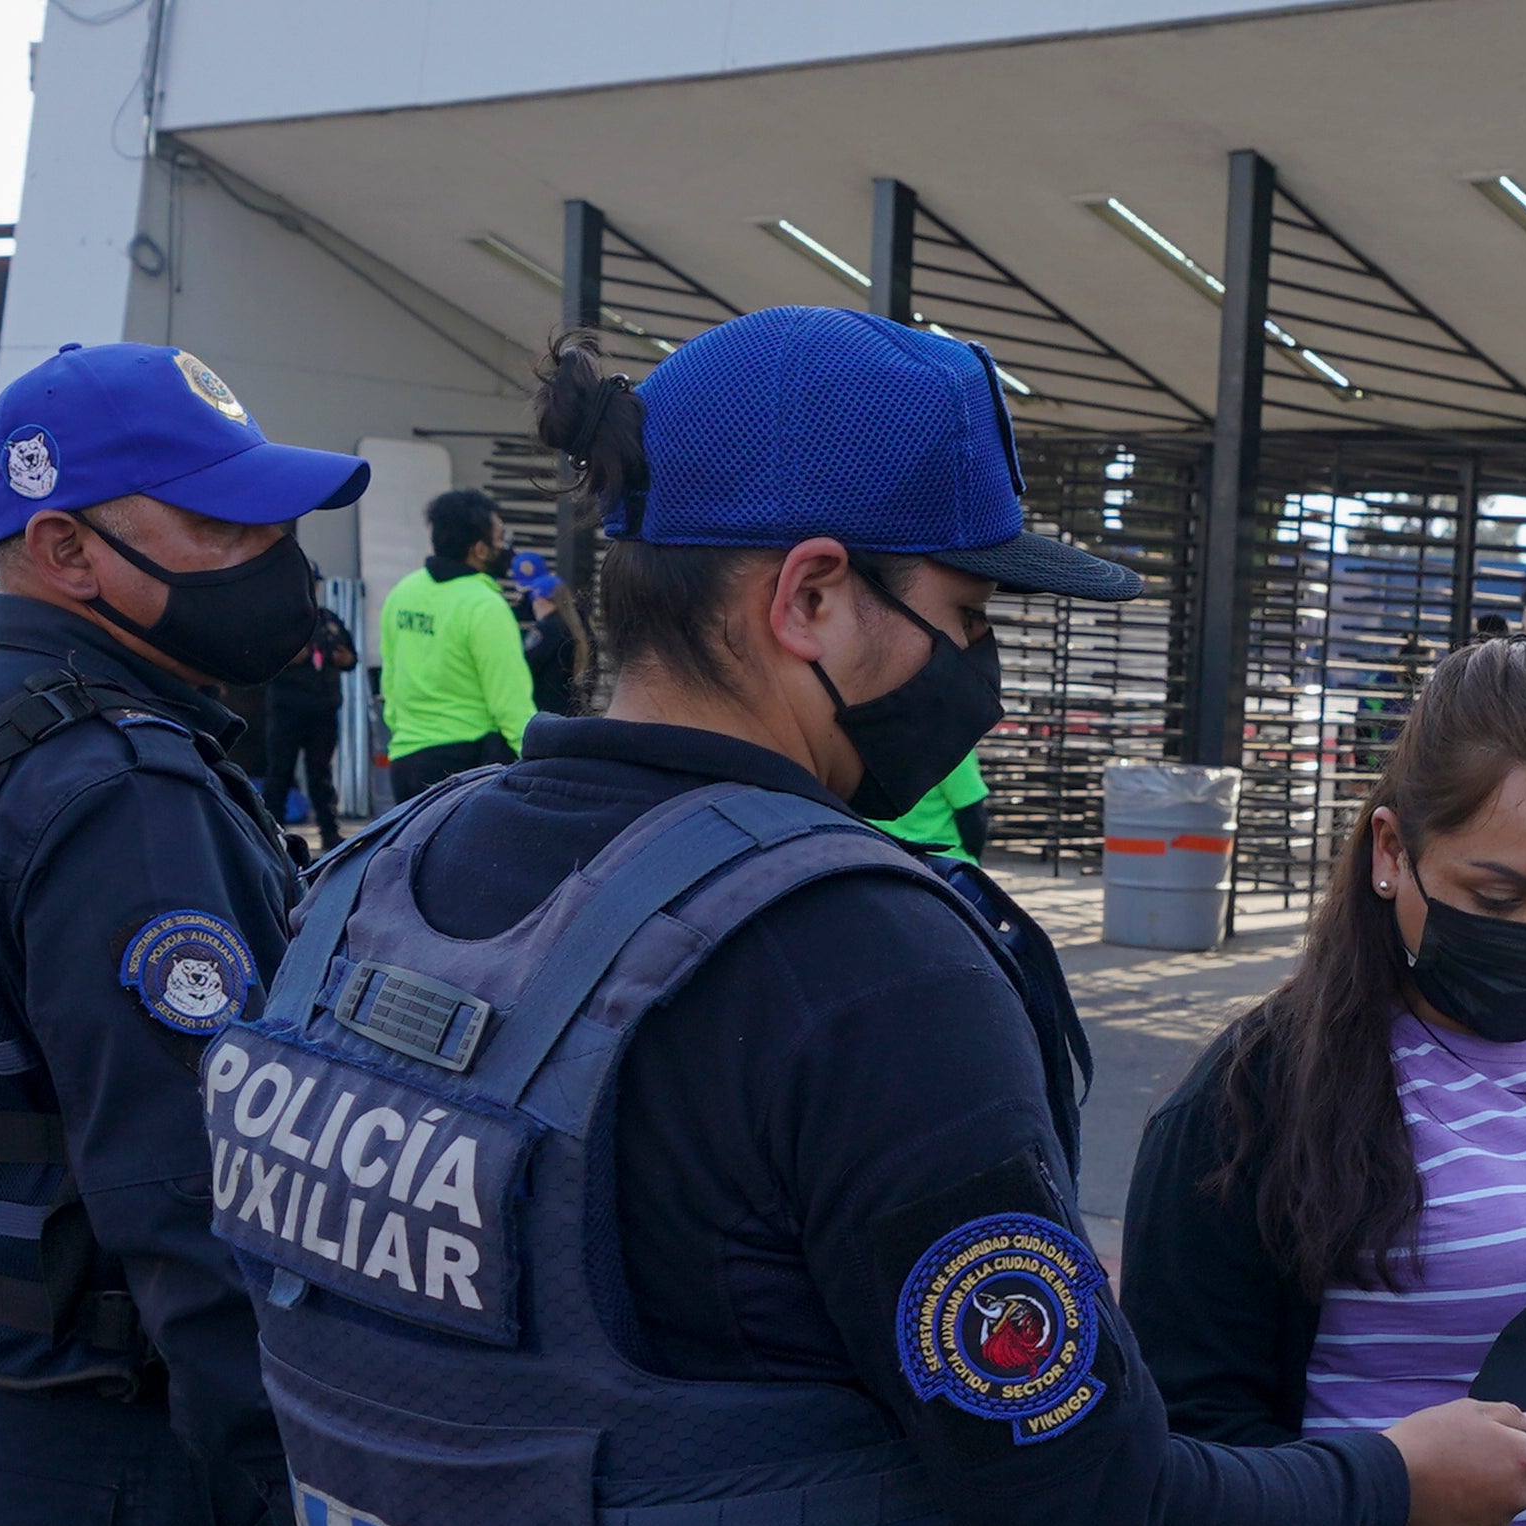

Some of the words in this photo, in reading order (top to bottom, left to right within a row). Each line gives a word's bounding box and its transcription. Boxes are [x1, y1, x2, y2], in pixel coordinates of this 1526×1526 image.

[161, 918, 175, 929] DE
[148, 933, 186, 965] POLICIA
[191, 931, 236, 965] AUXILIAR
[155, 1001, 196, 1029] SECTOR
[207, 1043, 483, 1228] POLICÍA
[208, 1130, 484, 1311] UXILIAR
[960, 1273, 977, 1293] DE
[975, 1263, 993, 1279] LA
[994, 1256, 1039, 1272] CIUDAD
[1039, 1264, 1056, 1283] DE
[919, 1294, 942, 1371] SECRETARIA
[931, 1274, 949, 1293] DE
[944, 1235, 1009, 1277] SEGURIDAD
[1013, 1234, 1078, 1279] CIUDADANA
[941, 1290, 966, 1349] AUXILIAR
[1052, 1278, 1079, 1329] MEXICO
[947, 1351, 990, 1393] POLICIA
[1002, 1364, 1065, 1398] SECTOR
[1060, 1340, 1076, 1364] 59
[1028, 1387, 1091, 1433] VIKINGO
